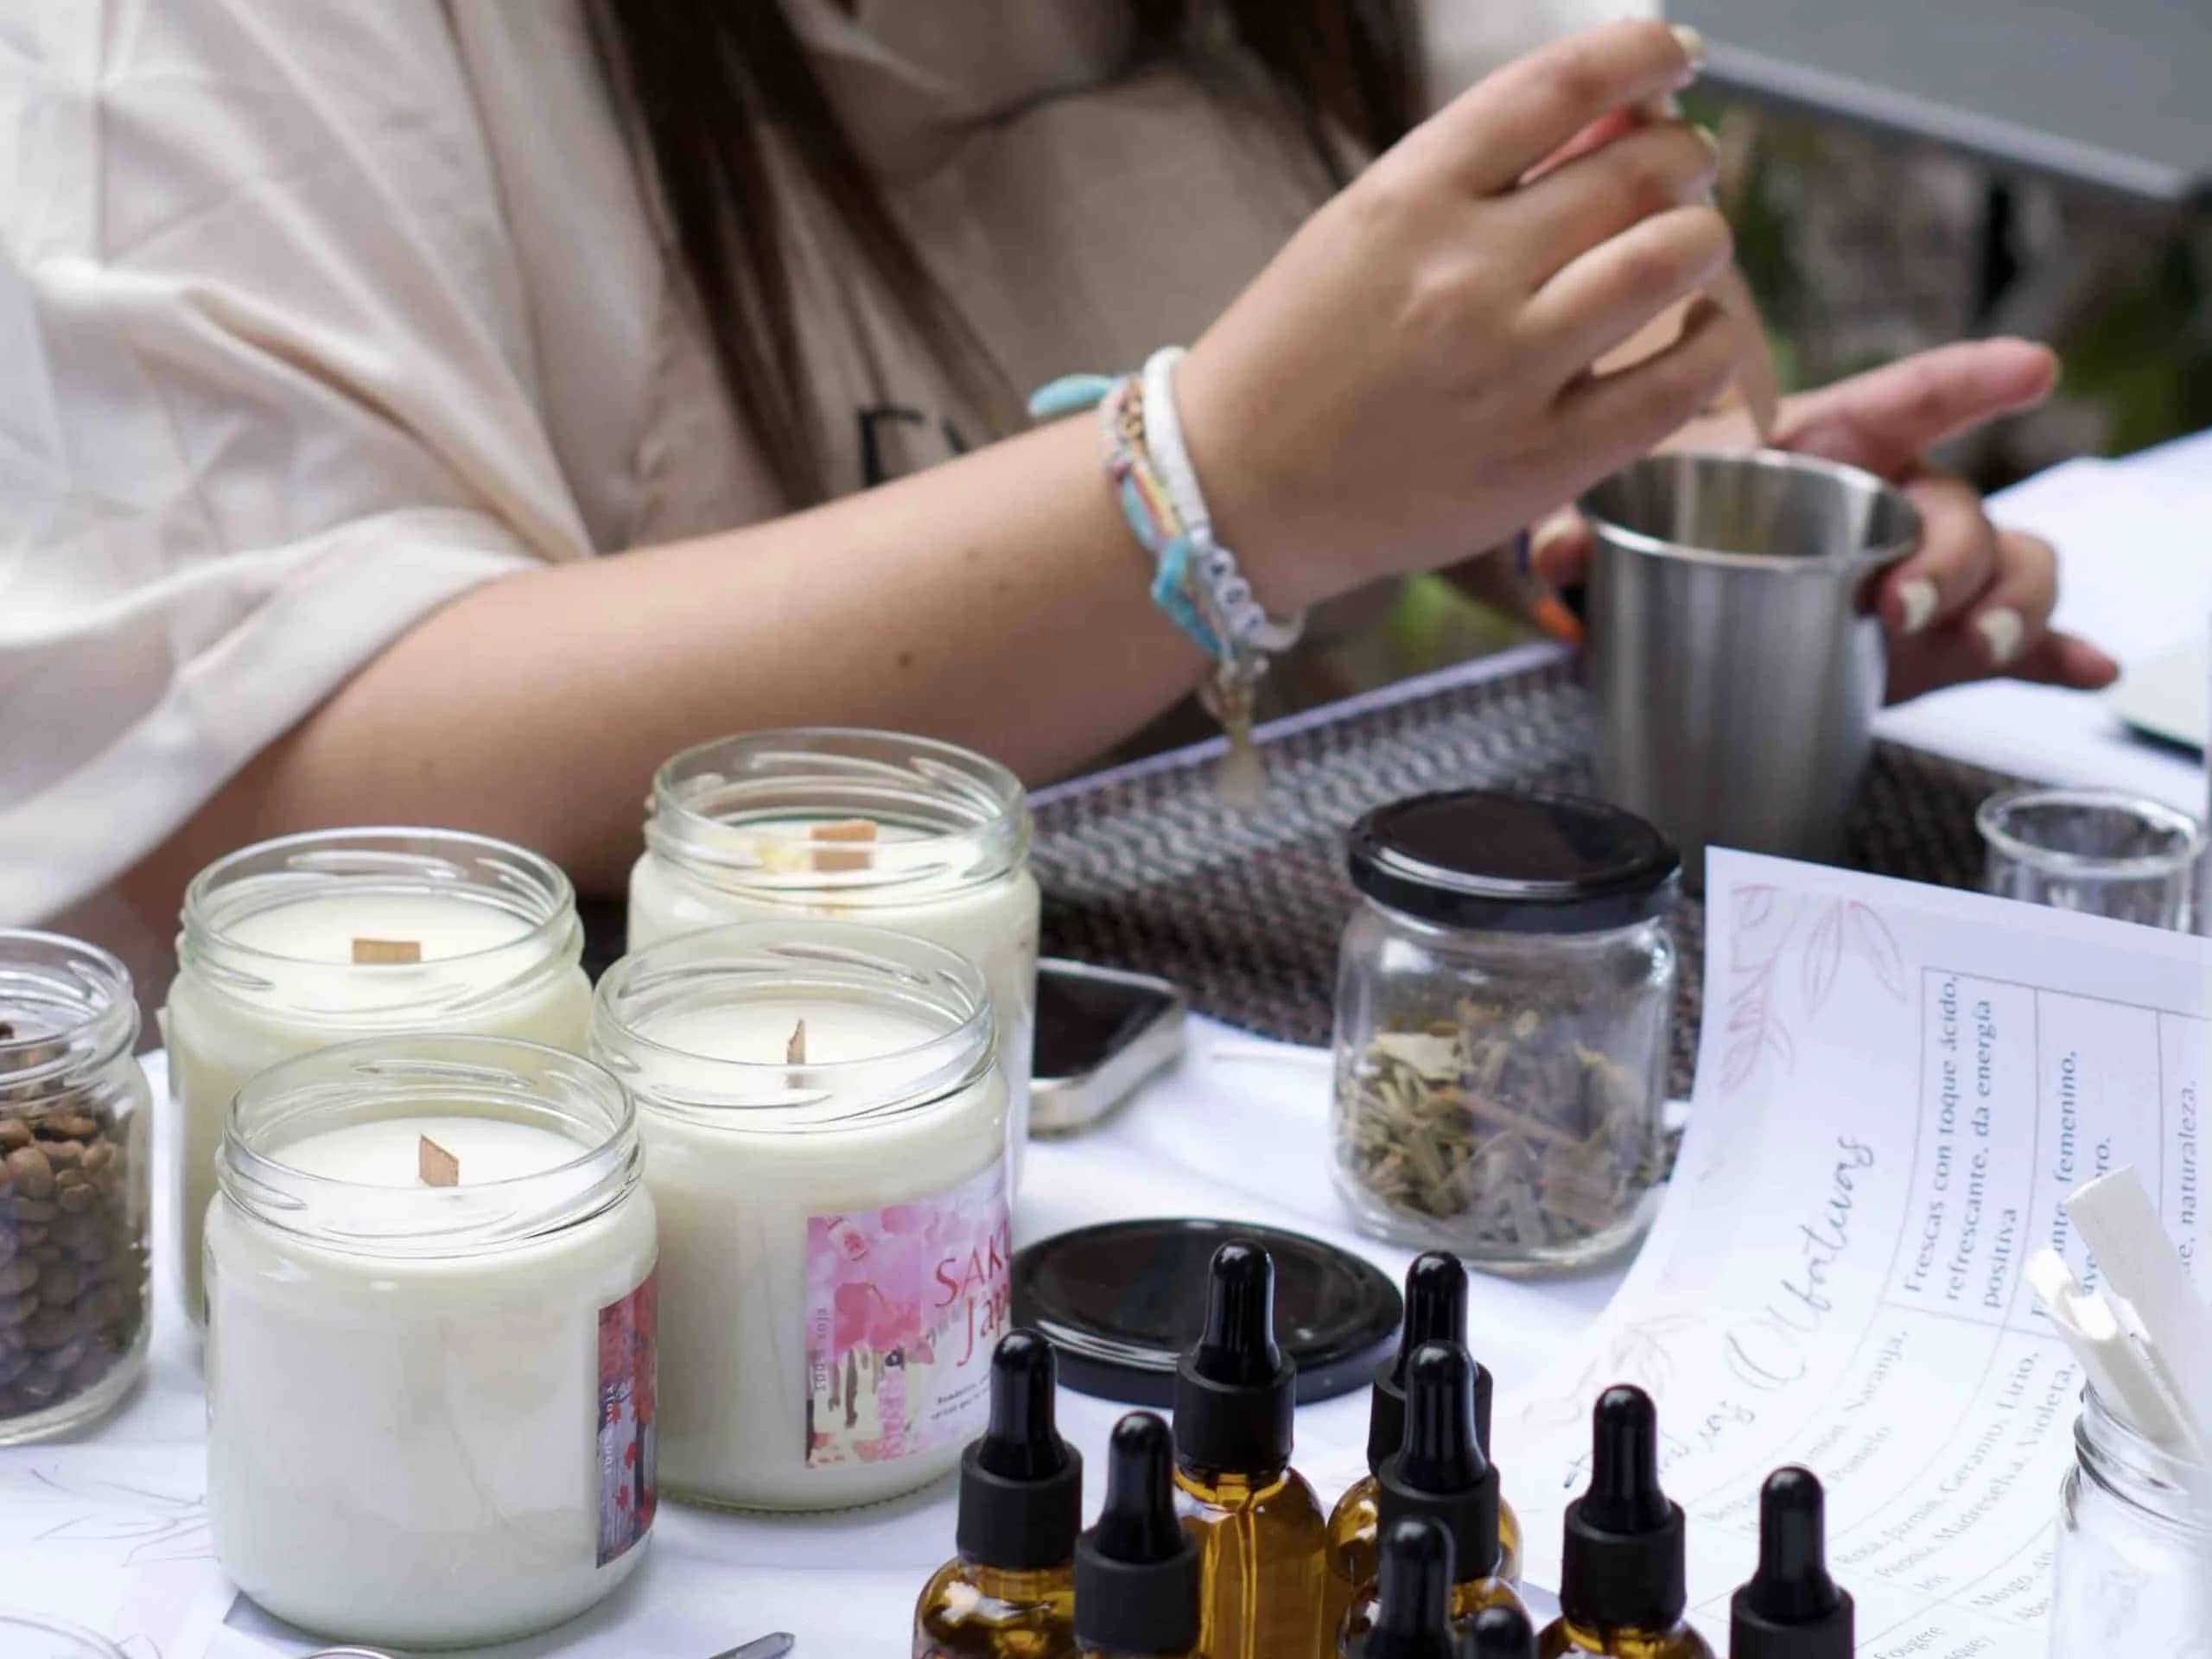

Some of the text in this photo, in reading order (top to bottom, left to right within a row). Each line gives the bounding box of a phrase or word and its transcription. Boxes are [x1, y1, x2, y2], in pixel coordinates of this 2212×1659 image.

[1972, 1000, 1997, 1098] energía
[1938, 1060, 1961, 1135] toque
[1970, 1106, 1991, 1138] da
[1933, 1145, 1954, 1192] con
[1904, 1200, 1944, 1294] Frescas
[1983, 1208, 2018, 1310] positiva
